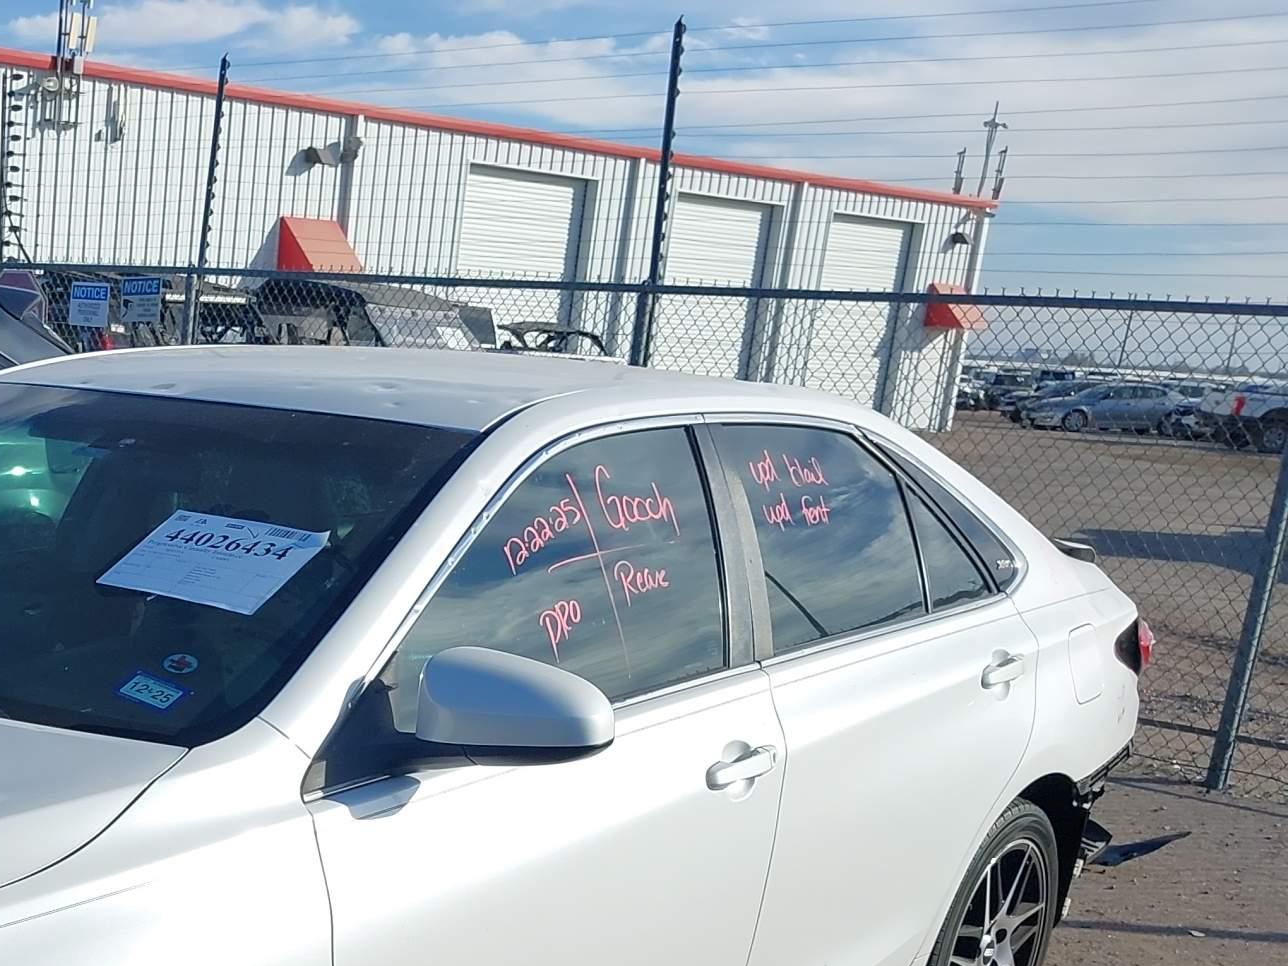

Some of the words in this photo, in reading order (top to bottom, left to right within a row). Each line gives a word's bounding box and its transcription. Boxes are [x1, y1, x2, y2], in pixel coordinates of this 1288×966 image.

[73, 286, 108, 300] NOTICE
[123, 279, 160, 294] NOTICE
[594, 463, 681, 537] Gooch
[164, 527, 295, 561] 44026434
